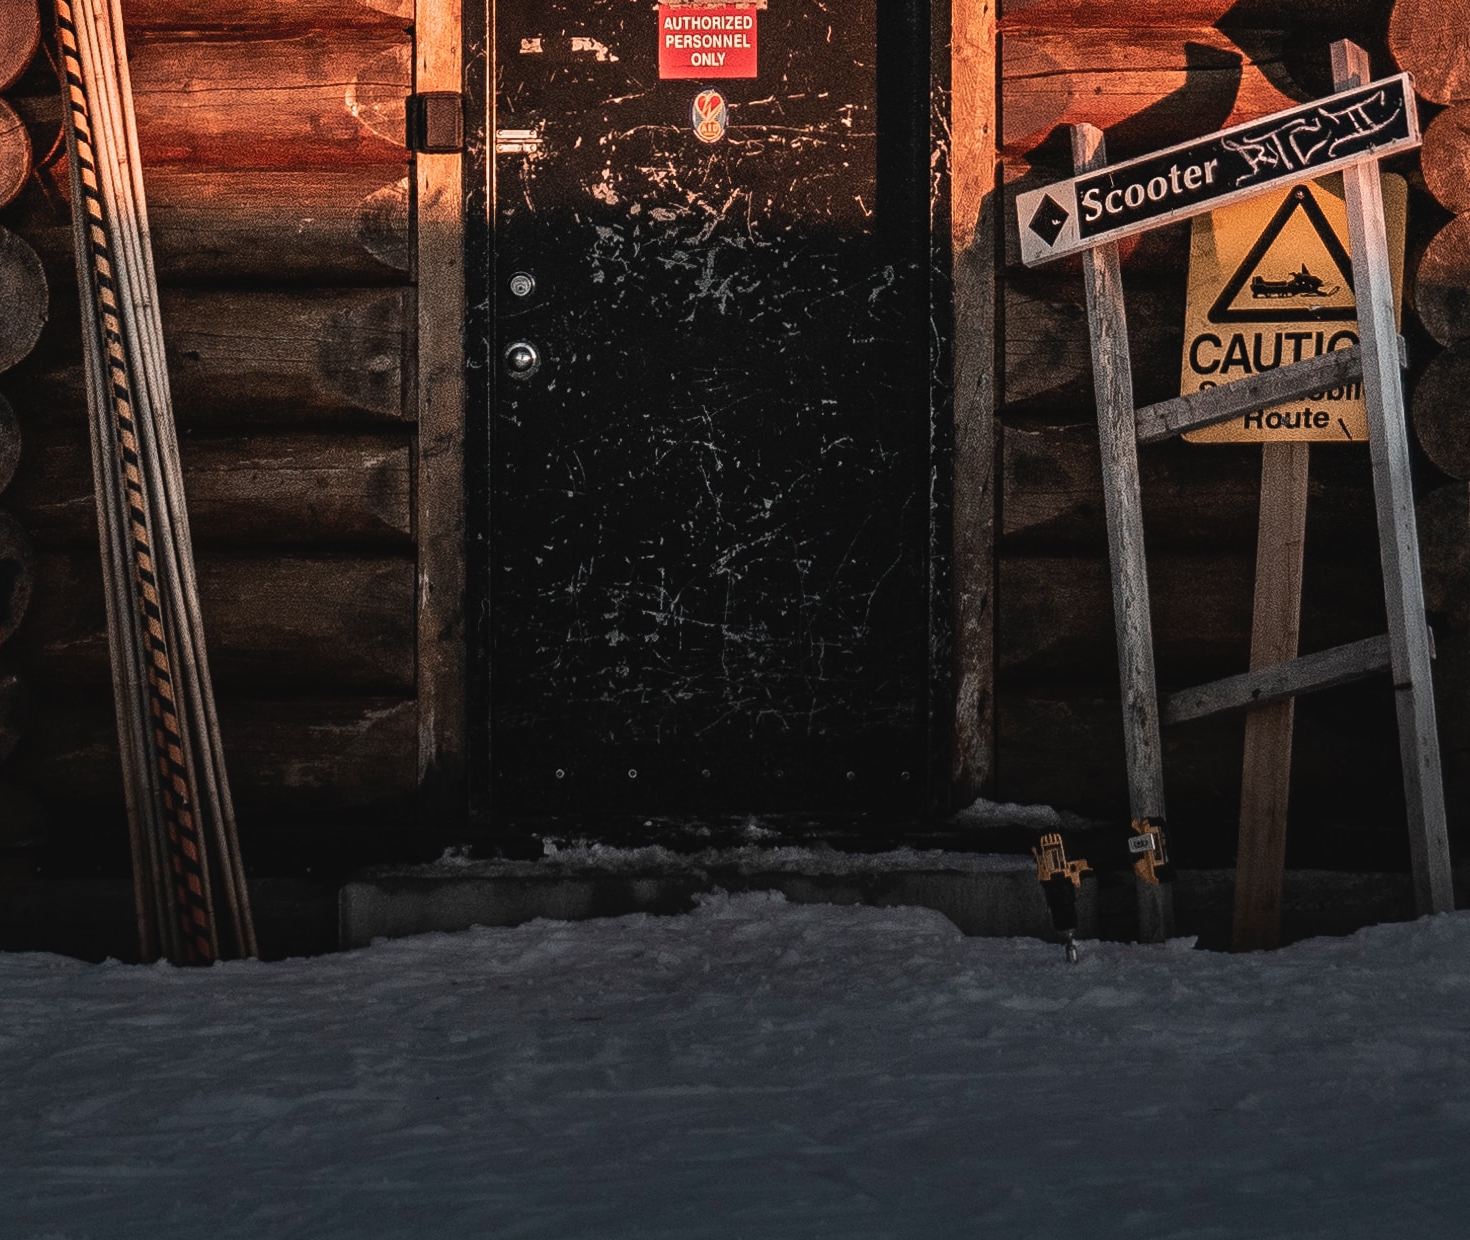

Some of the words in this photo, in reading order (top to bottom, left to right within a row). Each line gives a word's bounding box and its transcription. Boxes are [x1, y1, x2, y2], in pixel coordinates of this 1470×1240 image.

[664, 16, 753, 30] AUTHORIZED
[665, 34, 751, 48] PERSONNEL
[690, 52, 726, 67] ONLY
[1081, 159, 1219, 222] Scooter
[1243, 407, 1330, 429] Route
